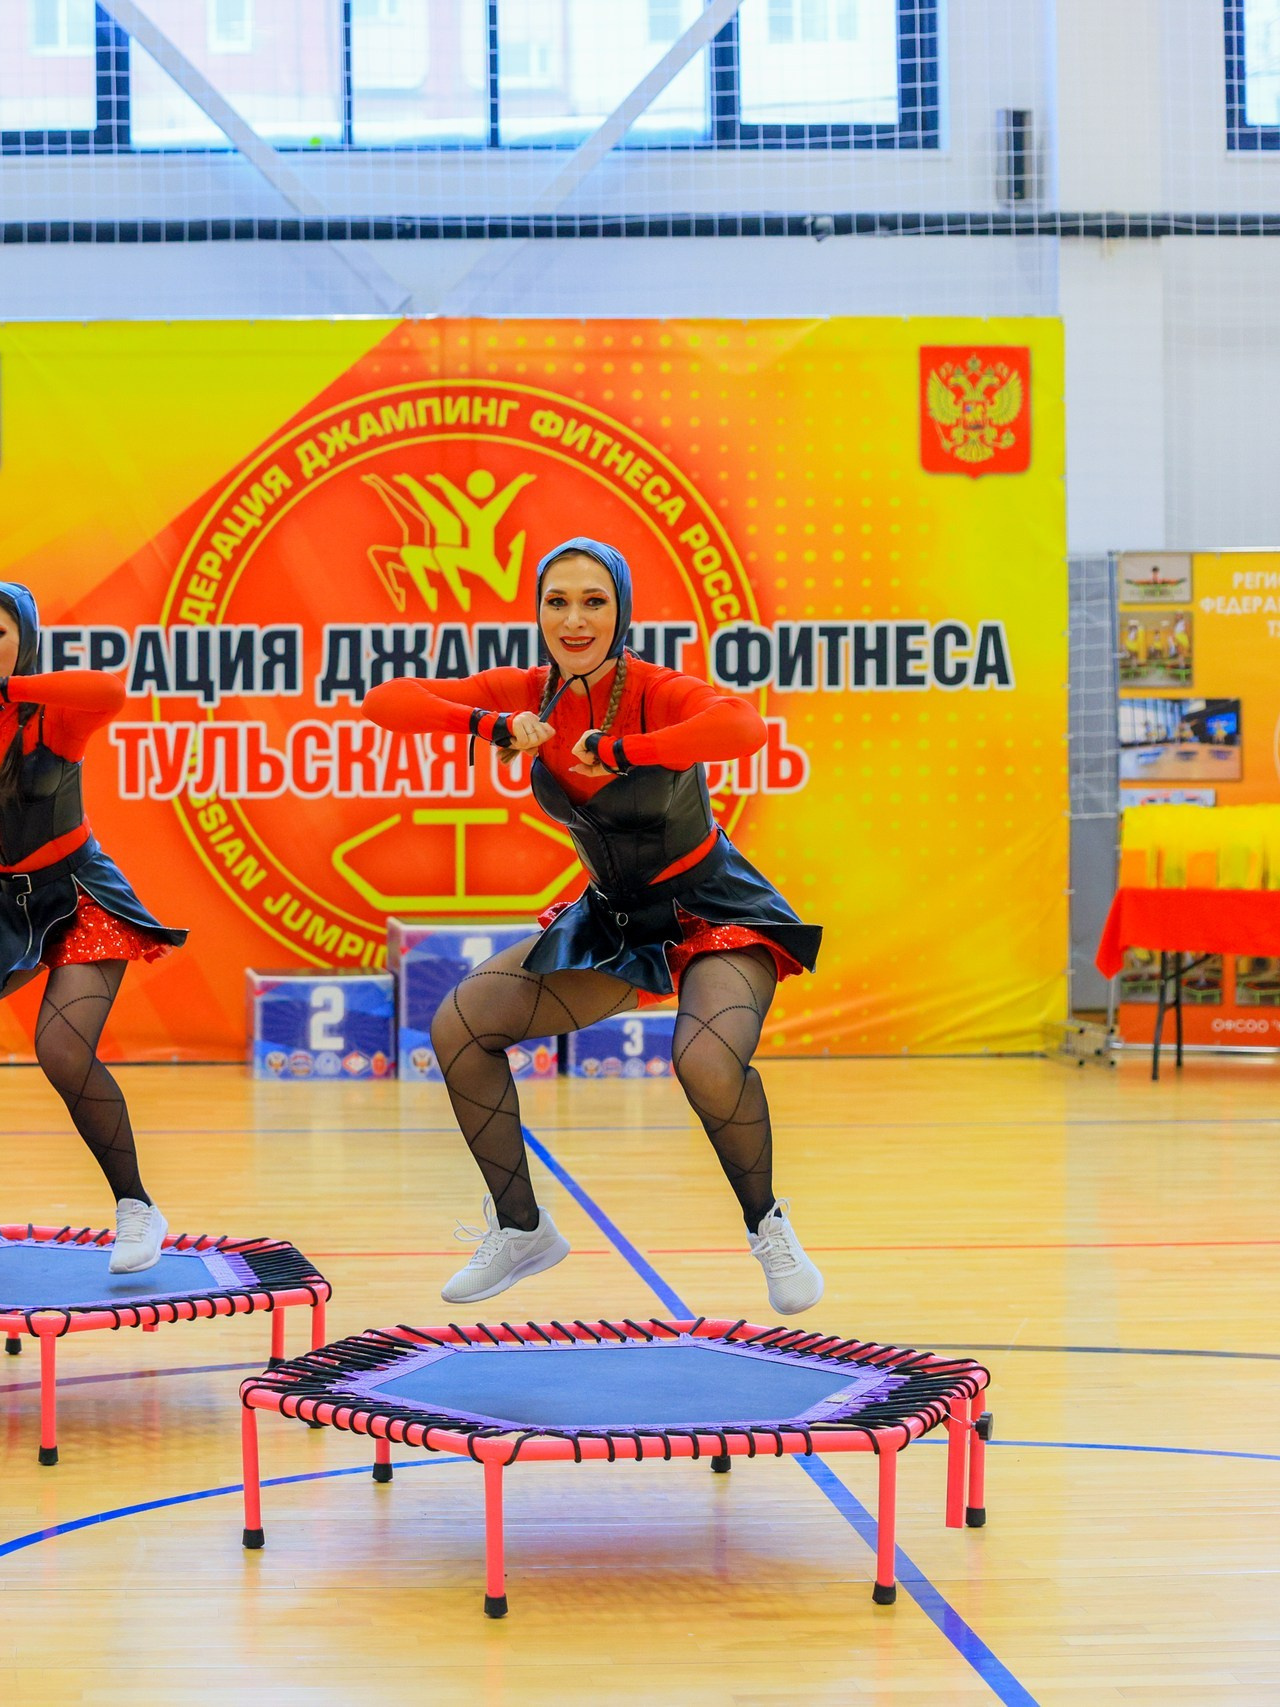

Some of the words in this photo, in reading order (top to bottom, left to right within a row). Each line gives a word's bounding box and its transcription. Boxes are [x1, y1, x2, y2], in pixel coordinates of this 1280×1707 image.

[178, 464, 293, 627] ДЕРАЦИЯ
[294, 396, 521, 480] ДЖАМПИНГ
[529, 409, 687, 526] ФИТНЕСА
[678, 522, 743, 628] РОСС
[1199, 595, 1280, 616] ФЕДЕРА
[1232, 571, 1280, 590] РЕГИ
[319, 626, 693, 703] ДЖАМНГ
[714, 623, 1013, 689] ФИТНЕСА
[113, 723, 466, 796] ТУЛЬСКАЯ
[262, 891, 387, 968] JUMPI
[309, 985, 345, 1051] 2
[622, 1019, 645, 1056] 3
